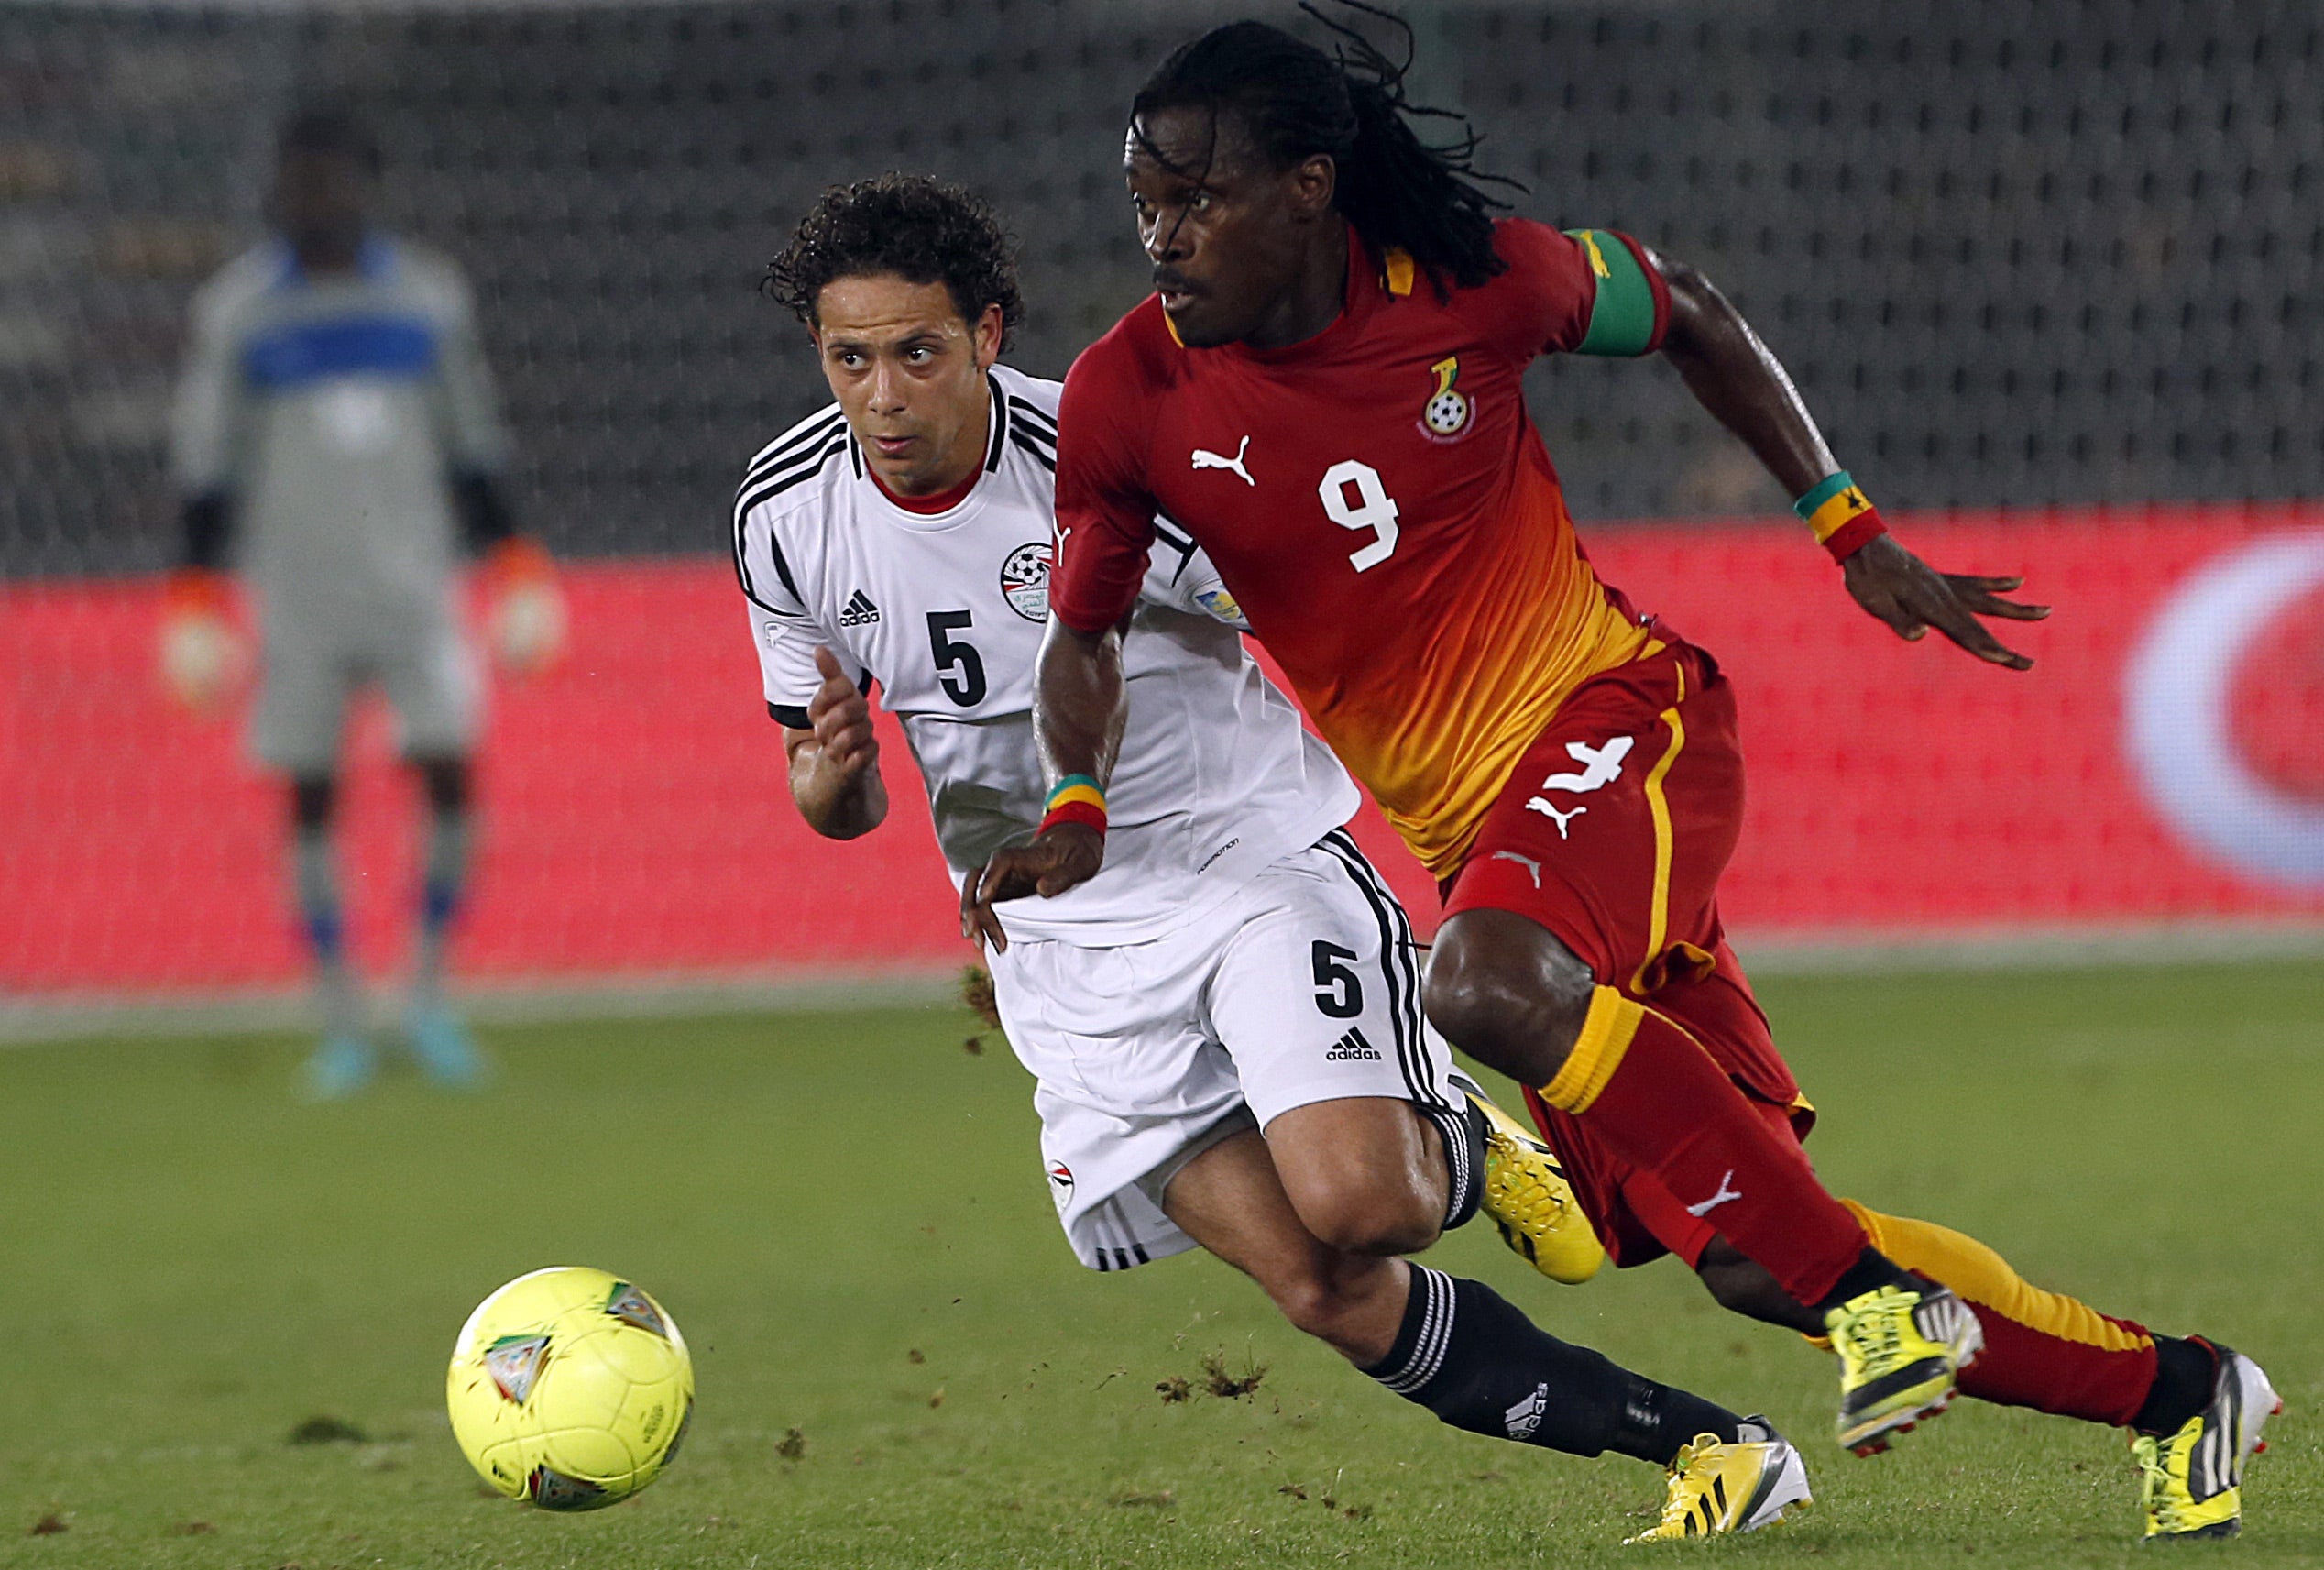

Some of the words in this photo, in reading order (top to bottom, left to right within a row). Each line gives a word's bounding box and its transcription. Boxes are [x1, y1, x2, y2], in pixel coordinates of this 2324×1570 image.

[1319, 459, 1399, 573] 9
[926, 609, 987, 708] 5
[1311, 939, 1364, 1018] 5
[1326, 1048, 1382, 1060] adidas
